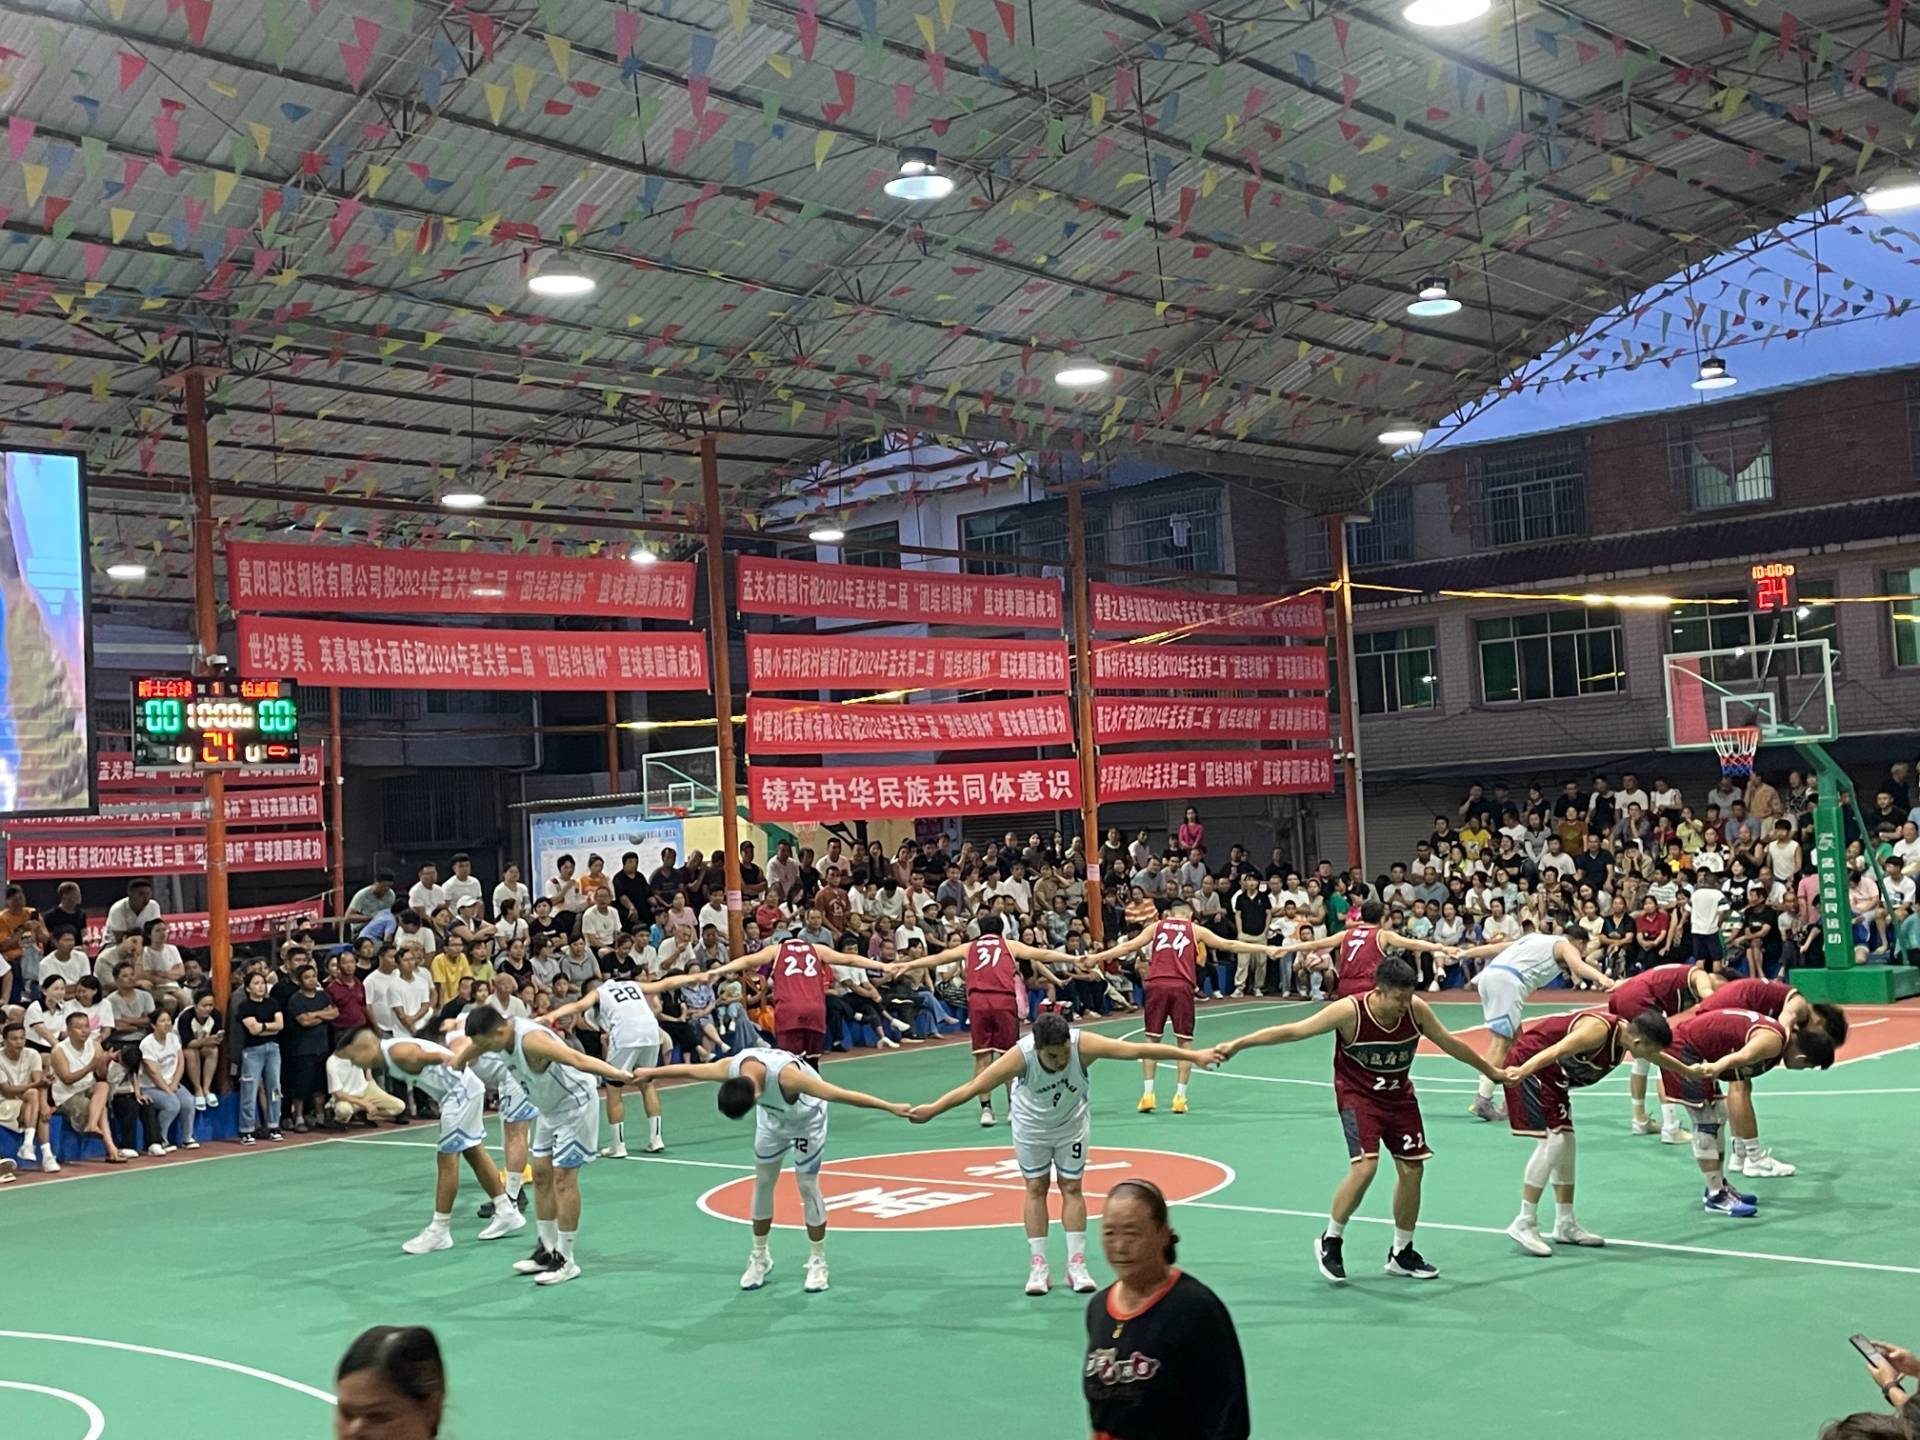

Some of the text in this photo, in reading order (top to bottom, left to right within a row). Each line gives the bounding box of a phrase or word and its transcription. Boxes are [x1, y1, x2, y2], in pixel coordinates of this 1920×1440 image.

[1757, 577, 1788, 608] 24
[145, 701, 181, 731] 00
[258, 701, 292, 731] 00
[762, 769, 1073, 812] 铸牢中华民族共同体意识
[1155, 931, 1191, 958] 24
[1347, 939, 1366, 962] 7
[784, 953, 818, 977] 28
[609, 985, 641, 1003] 28
[1373, 1076, 1400, 1091] 22
[1071, 1142, 1082, 1159] 9
